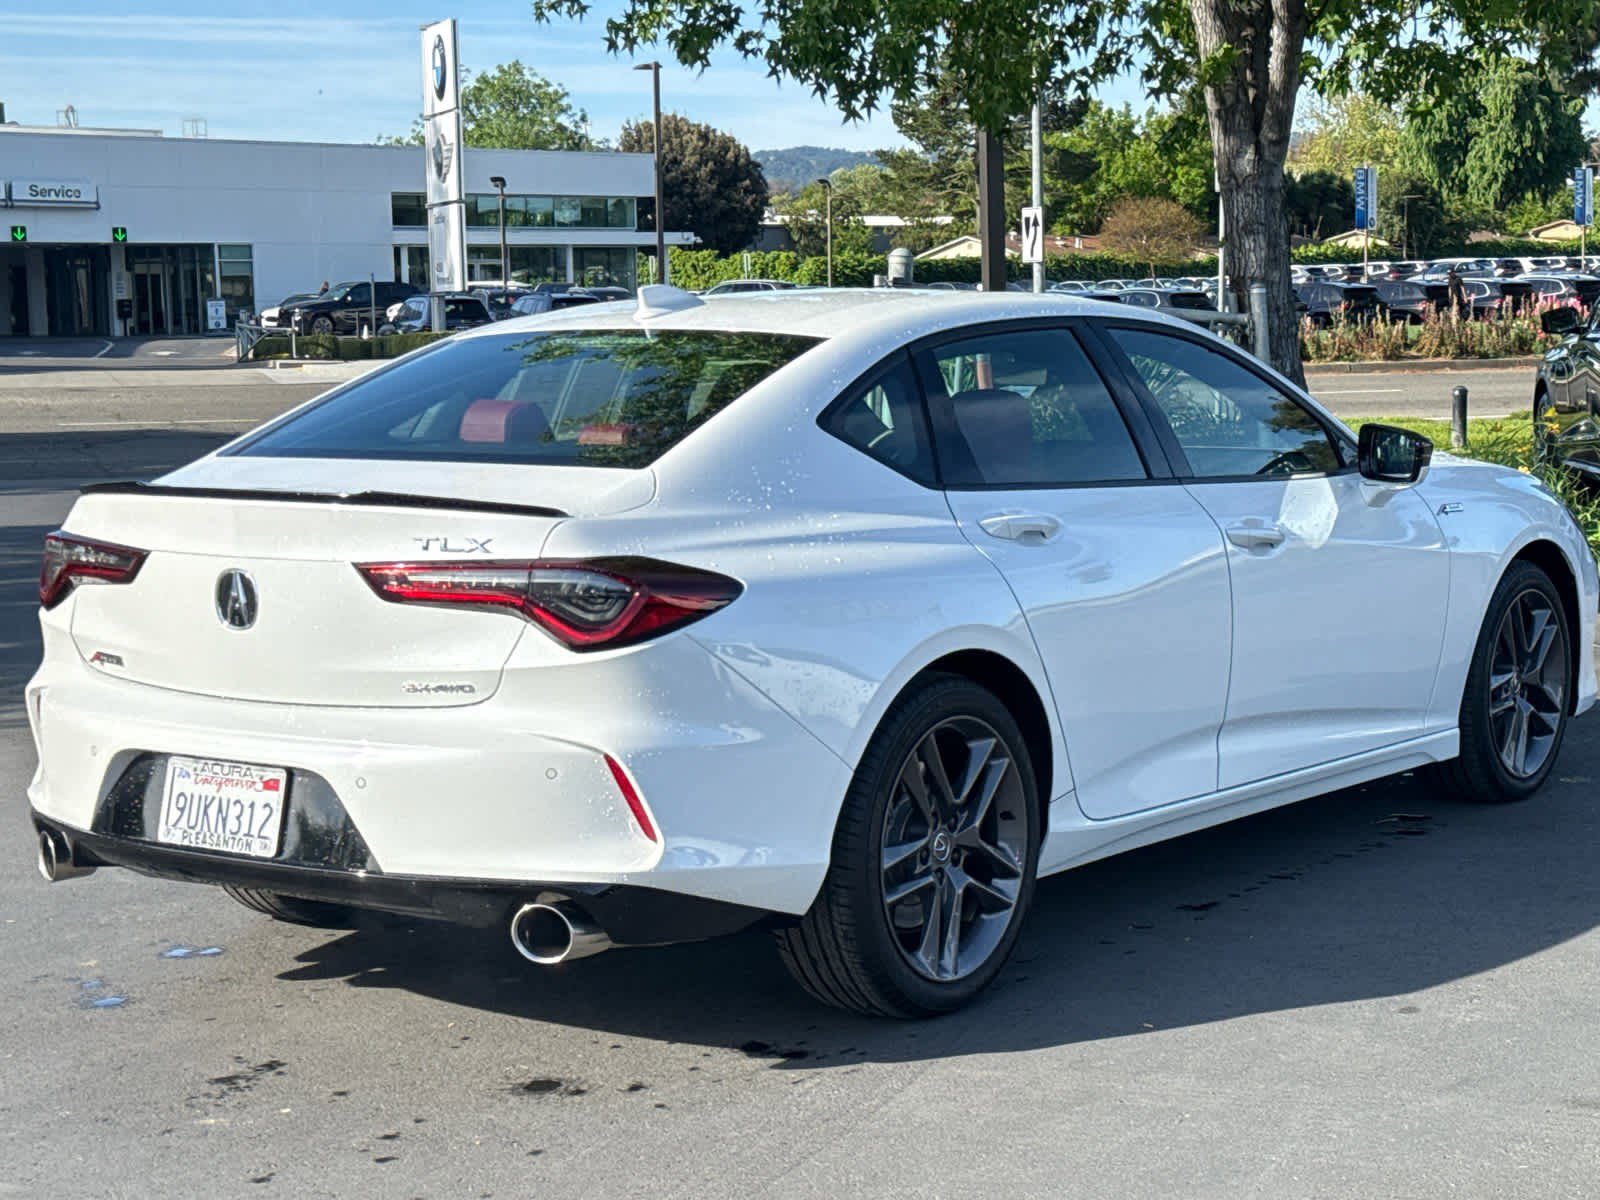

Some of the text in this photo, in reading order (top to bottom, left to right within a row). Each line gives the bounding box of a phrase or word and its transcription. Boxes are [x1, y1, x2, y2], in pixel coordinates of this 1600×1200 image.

[28, 183, 82, 199] Service
[1355, 169, 1366, 210] BMW
[1575, 169, 1584, 208] BMW
[413, 537, 494, 553] TLX
[199, 762, 254, 779] ACURA
[172, 791, 274, 841] 9UKN312
[181, 829, 254, 852] PLEASANTON
